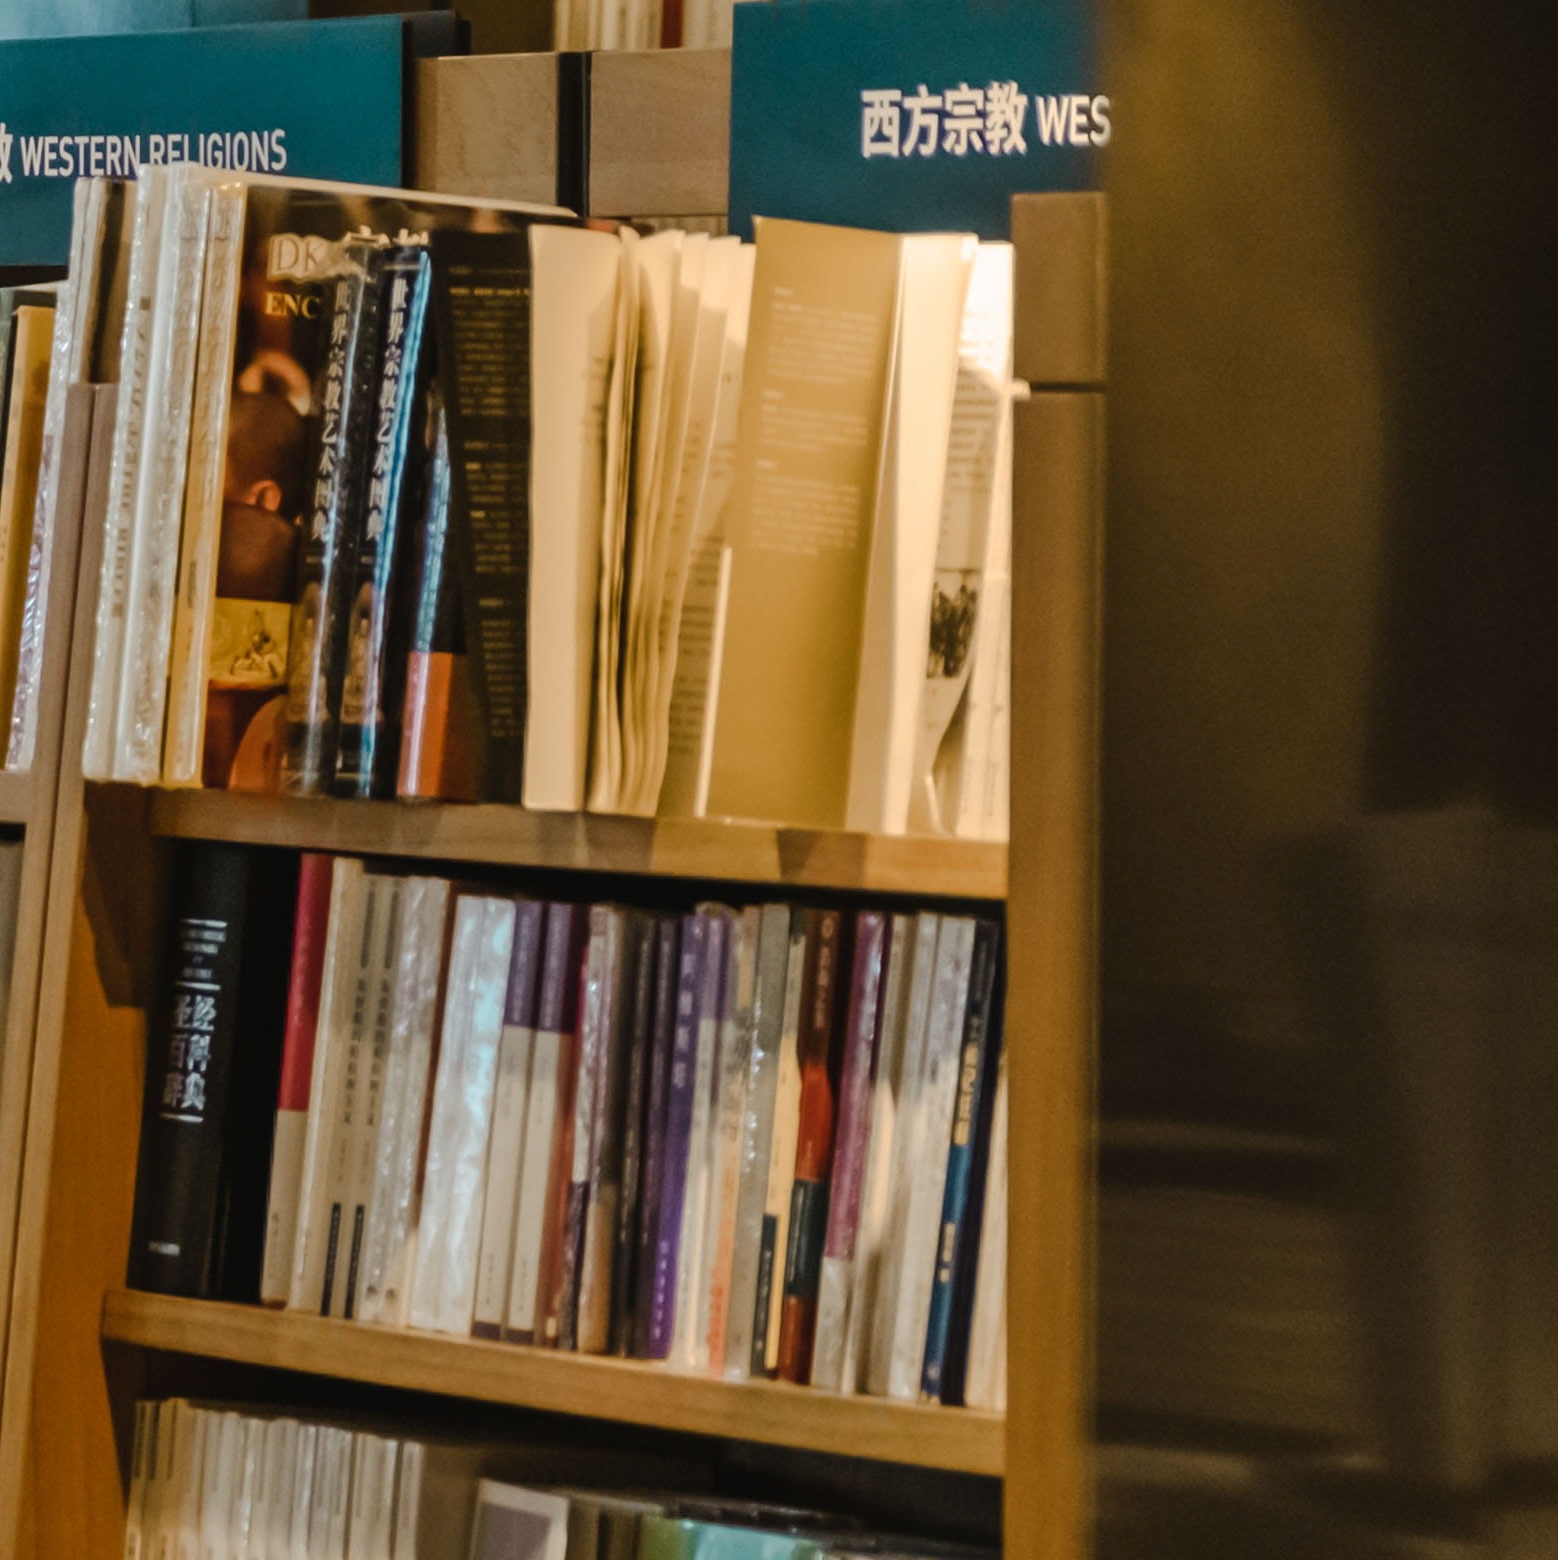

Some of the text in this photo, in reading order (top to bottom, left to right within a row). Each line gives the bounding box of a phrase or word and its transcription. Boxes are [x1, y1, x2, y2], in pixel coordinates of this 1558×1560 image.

[861, 80, 1112, 158] 西方宗教 WES
[19, 135, 141, 177] WESTERN
[276, 237, 322, 273] DK
